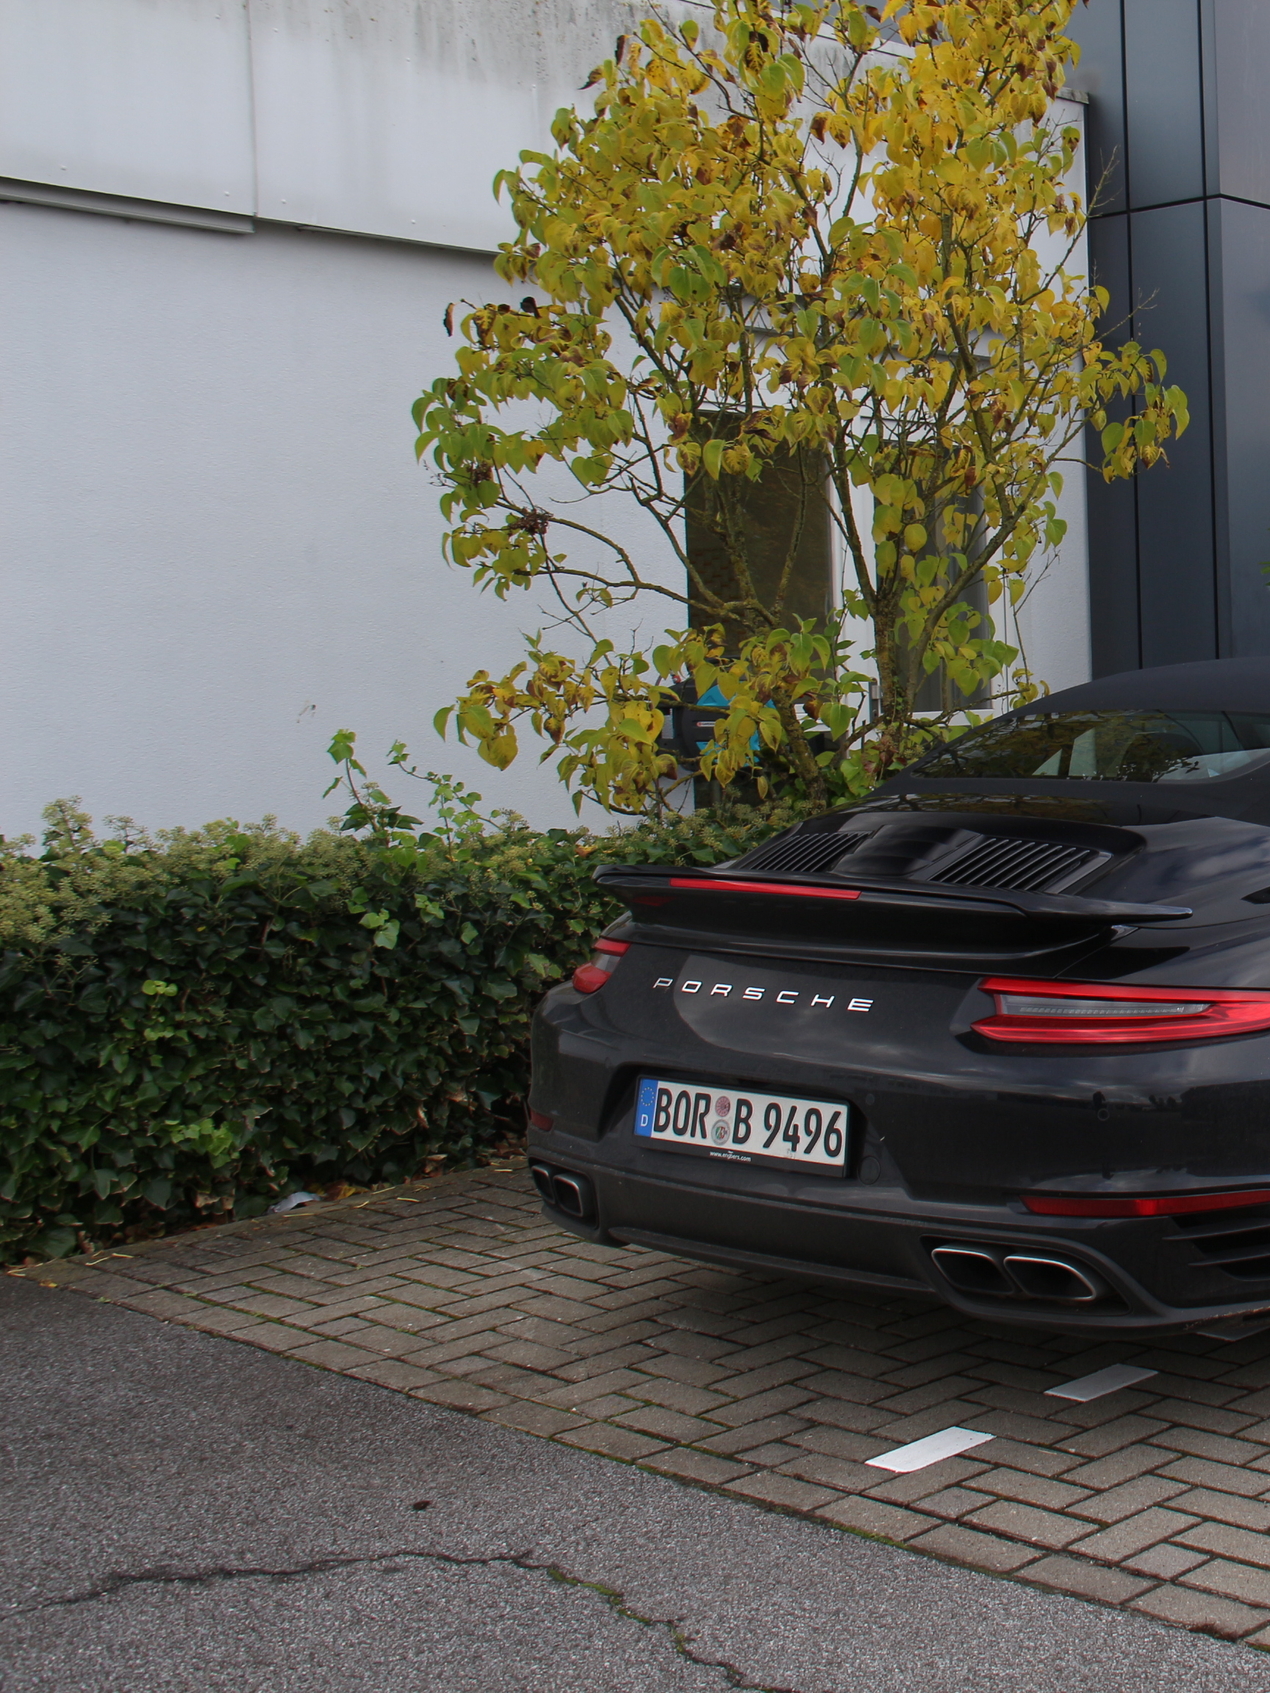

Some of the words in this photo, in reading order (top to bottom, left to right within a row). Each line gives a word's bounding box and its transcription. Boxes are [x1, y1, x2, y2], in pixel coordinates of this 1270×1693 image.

[652, 977, 874, 1012] PORSCHE
[640, 1114, 648, 1127] D
[653, 1087, 712, 1140] BOR
[732, 1098, 753, 1145] B
[763, 1102, 843, 1158] 9496
